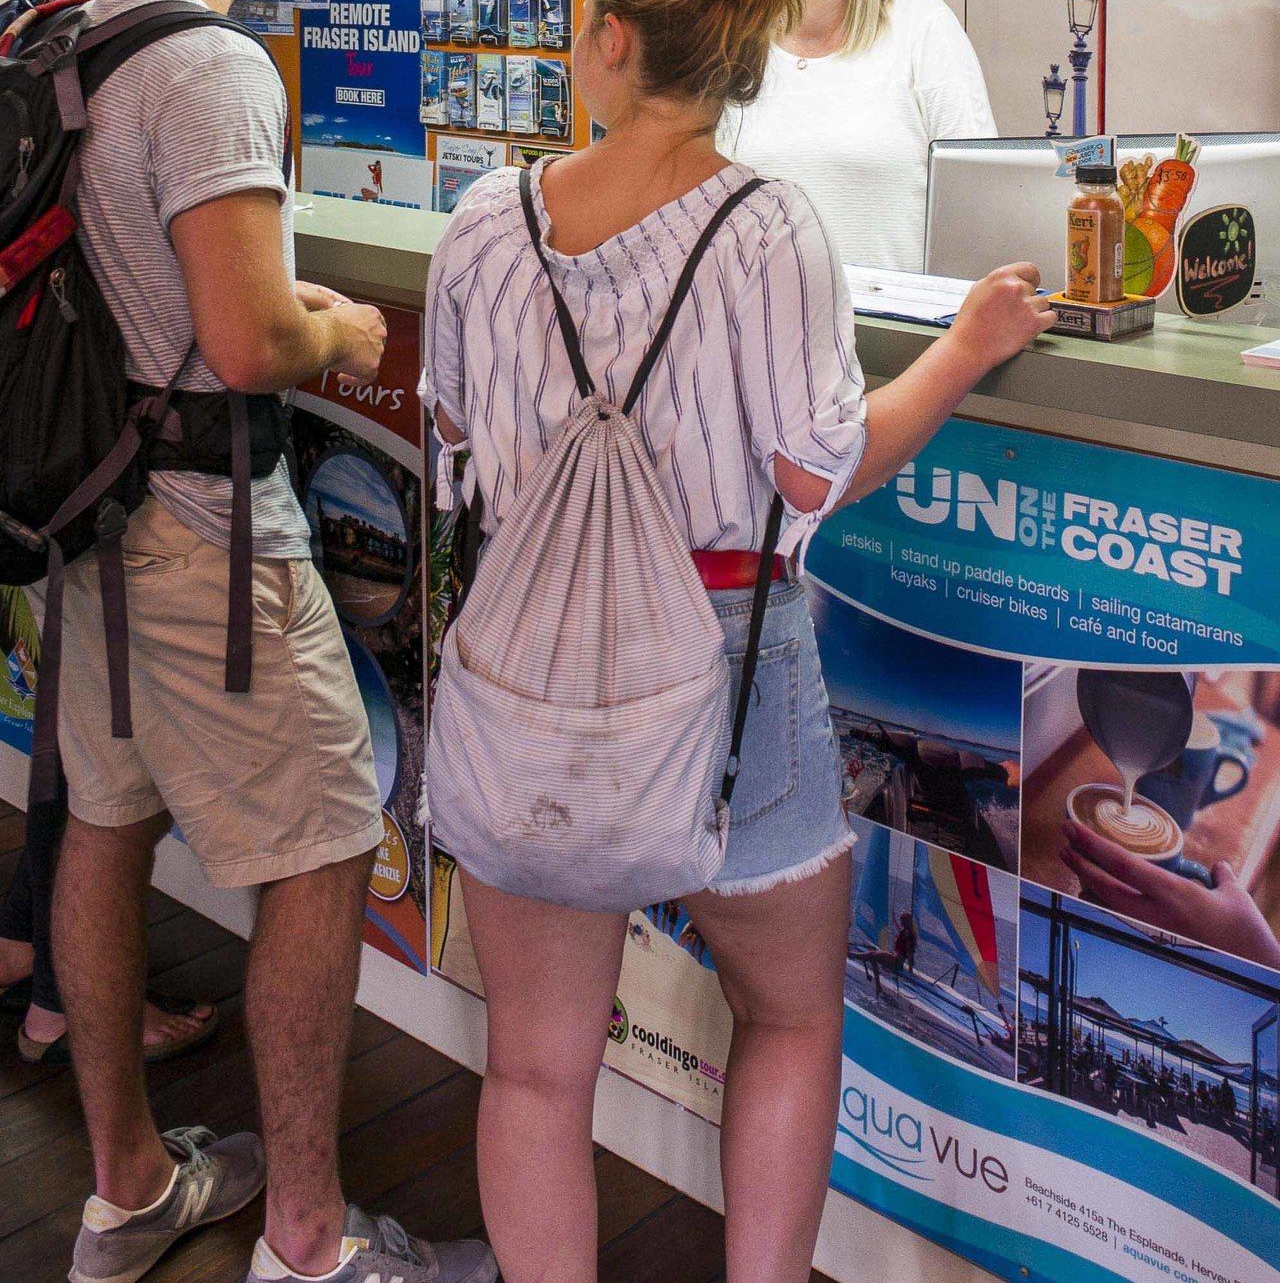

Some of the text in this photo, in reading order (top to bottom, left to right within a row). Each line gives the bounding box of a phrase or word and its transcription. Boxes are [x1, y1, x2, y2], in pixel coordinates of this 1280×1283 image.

[329, 3, 390, 26] REMOTE
[303, 28, 420, 54] FRASER ISLAND
[337, 89, 384, 105] BOOK HERE
[441, 152, 484, 165] JETSKI TOURS
[1068, 212, 1095, 227] Keri
[1183, 240, 1253, 283] Welcome!
[1057, 310, 1085, 325] Keri
[890, 462, 1018, 542] UN
[1062, 492, 1243, 560] FRASER
[1060, 525, 1242, 596] COAST
[841, 529, 1244, 647] jetskis stand up paddle boards sailing catamarans
[890, 565, 1178, 656] kayaks cruiser bikes café and food
[631, 1043, 679, 1075] FRASER
[929, 1126, 1010, 1195] vue
[1024, 1176, 1077, 1211] Beachside
[1079, 1205, 1104, 1226] 415a
[1107, 1217, 1127, 1237] The
[1129, 1228, 1188, 1269] Esplanade,
[1025, 1195, 1109, 1243] +61 7 4125 5528
